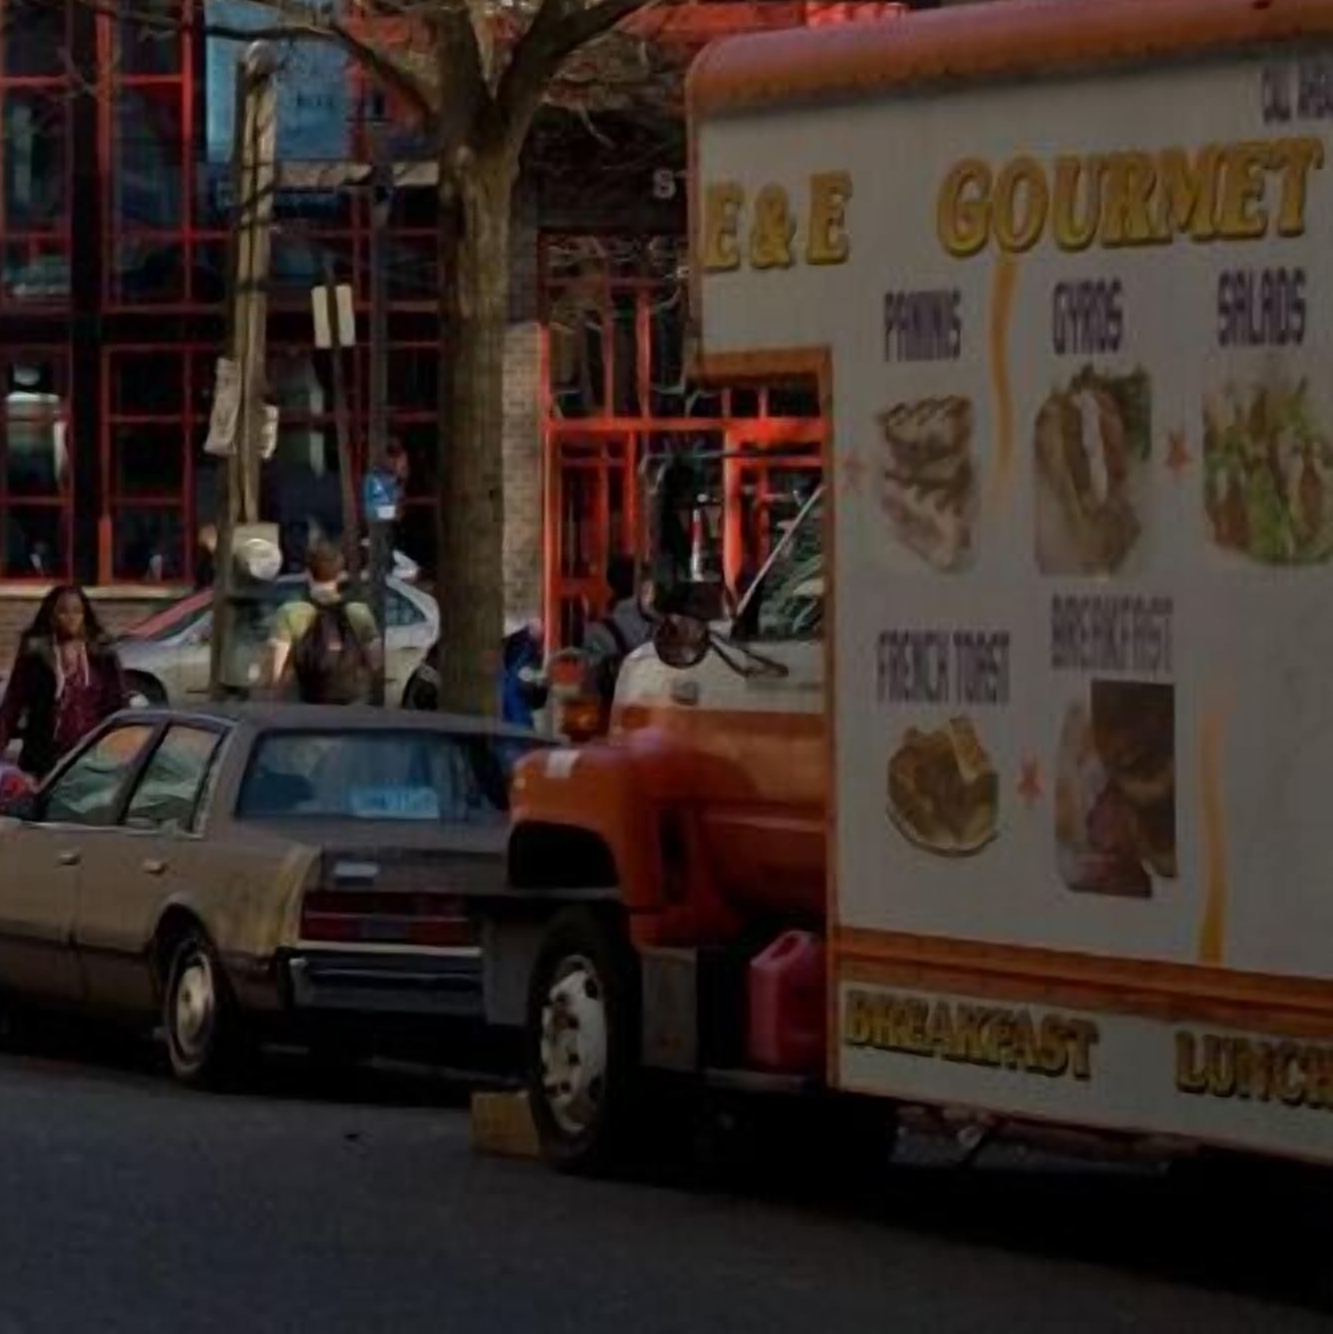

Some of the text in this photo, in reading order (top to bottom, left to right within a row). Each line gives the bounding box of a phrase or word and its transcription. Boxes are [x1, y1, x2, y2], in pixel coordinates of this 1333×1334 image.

[937, 137, 1324, 258] GOURMET
[1053, 278, 1123, 356] GYROS
[1218, 268, 1306, 347] SALADS
[846, 989, 1100, 1082] BREAKFAST
